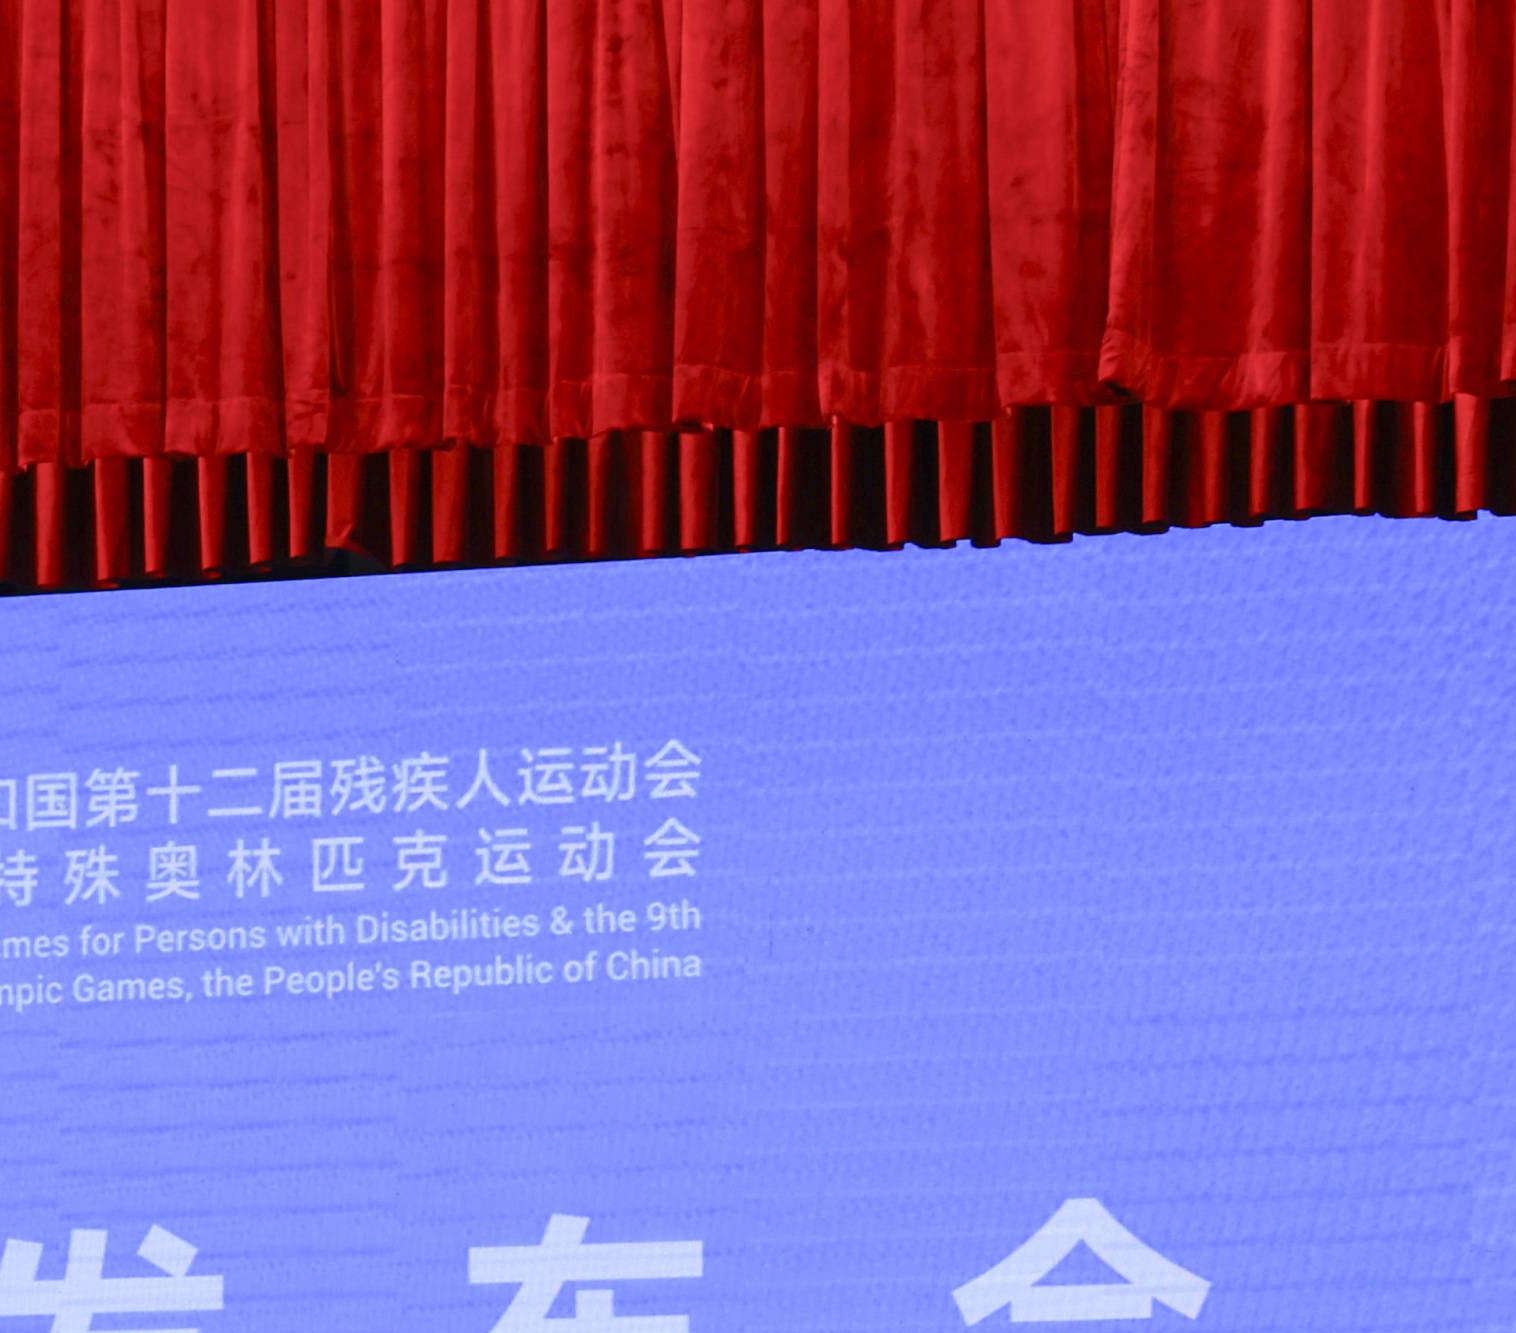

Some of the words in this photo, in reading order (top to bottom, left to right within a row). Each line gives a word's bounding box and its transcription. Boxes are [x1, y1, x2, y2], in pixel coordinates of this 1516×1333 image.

[79, 924, 125, 956] for
[134, 924, 267, 953] Persons
[276, 914, 346, 947] with
[356, 907, 540, 944] Disabilities
[550, 905, 574, 936] &
[583, 903, 637, 934] the
[646, 899, 702, 931] 9th
[72, 973, 192, 1003] Games,
[201, 967, 254, 998] the
[263, 961, 399, 999] People's
[409, 953, 553, 995] Republic
[563, 950, 598, 983] of
[606, 948, 702, 981] China
